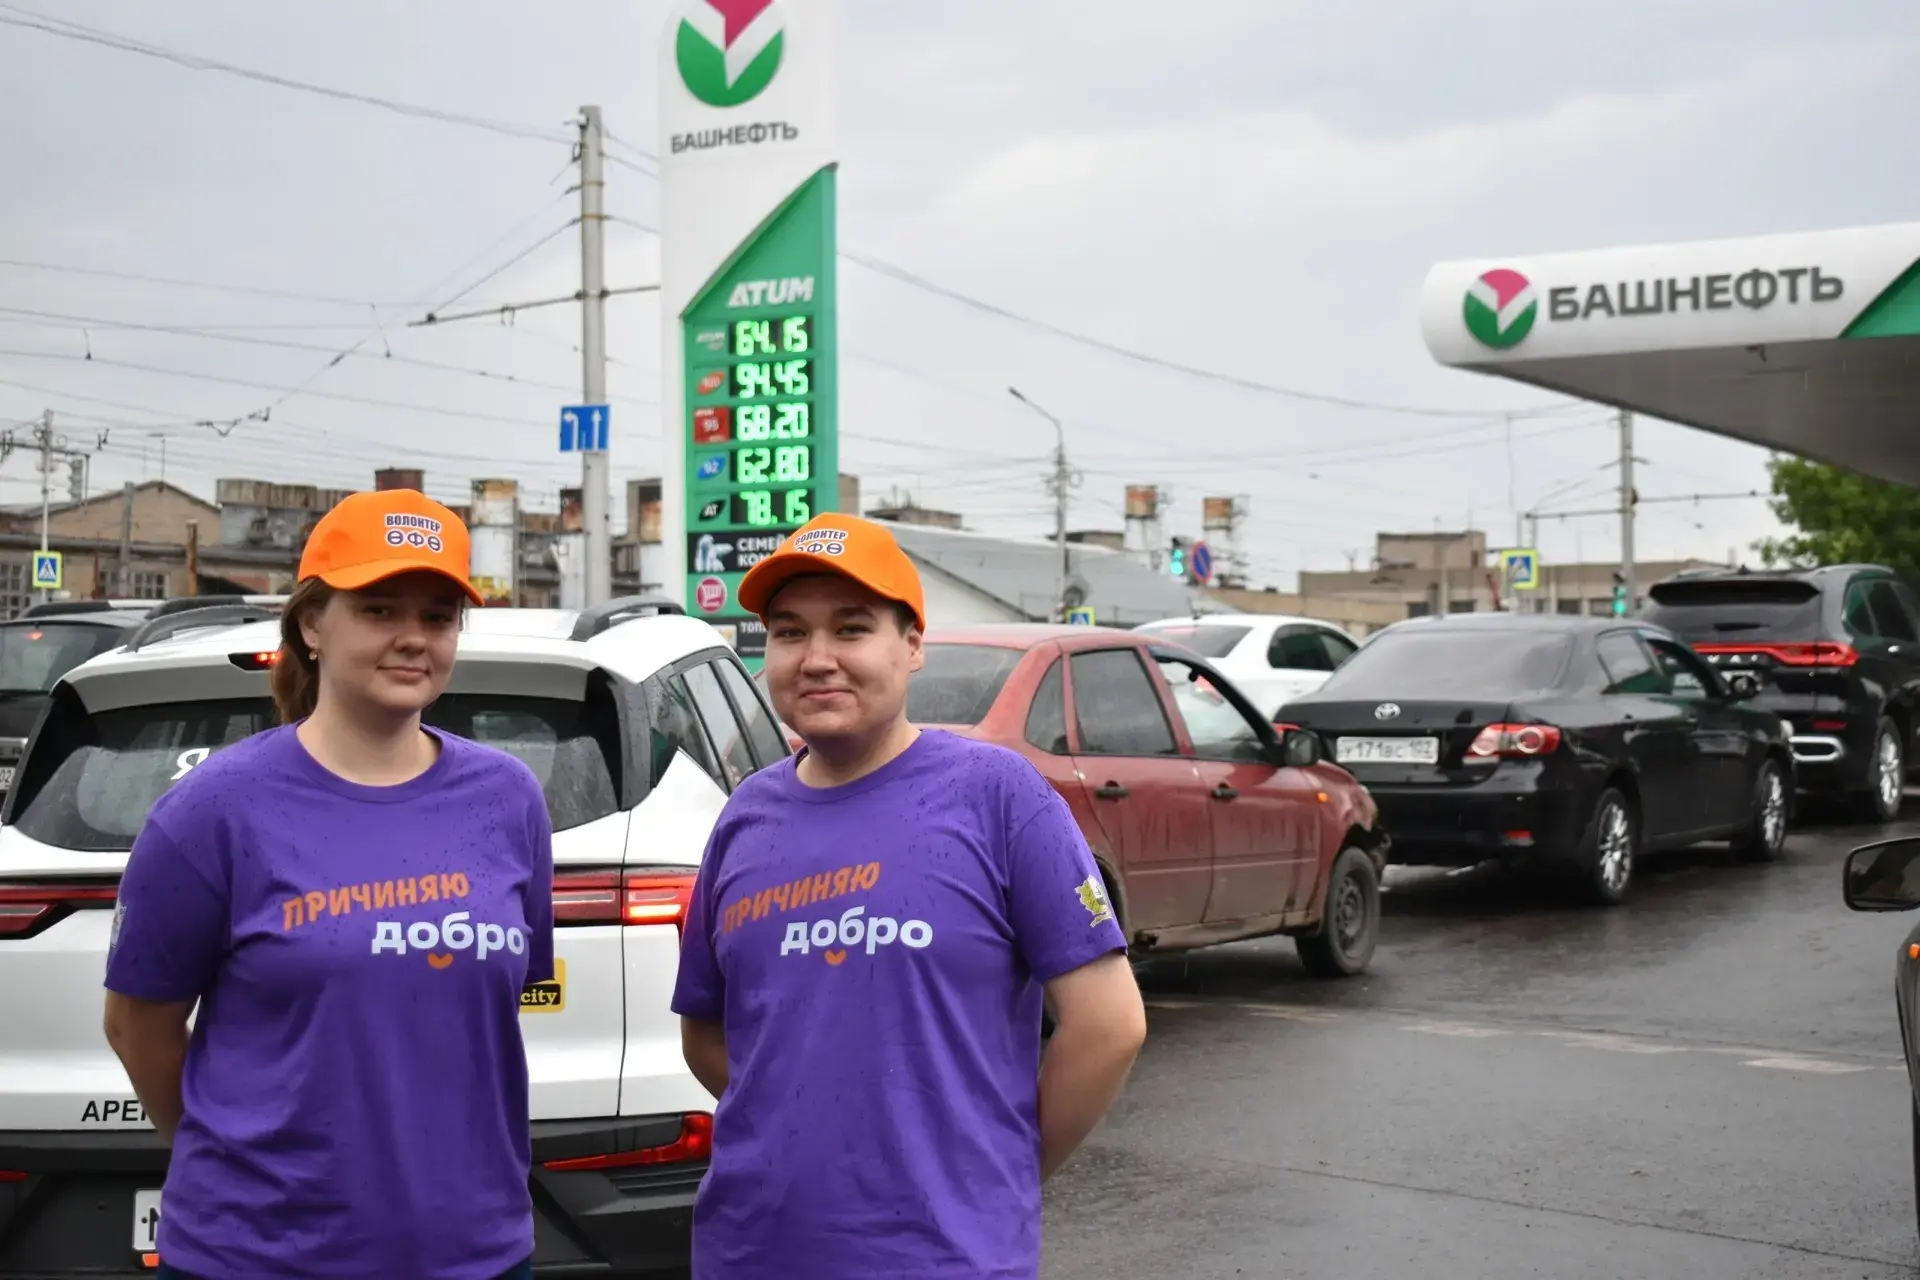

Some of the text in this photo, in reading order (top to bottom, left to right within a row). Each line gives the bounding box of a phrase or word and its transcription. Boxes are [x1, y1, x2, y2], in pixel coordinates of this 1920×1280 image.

[671, 122, 798, 154] БАШНЕФТЬ
[727, 275, 815, 307] ATUM
[1548, 266, 1844, 321] БАШНЕФТЬ
[736, 316, 808, 356] 64.15
[736, 359, 809, 399] 94.45
[737, 402, 809, 441] 68.20
[703, 461, 720, 475] 92
[737, 445, 809, 484] 62.80
[386, 515, 441, 533] ВОЛОНТЕР
[740, 488, 810, 526] 78.15
[795, 530, 847, 546] ВОЛОНТЕР
[282, 872, 470, 931] ПРИЧИНЯЮ
[722, 861, 880, 935] ПРИЧИНЯЮ
[371, 911, 525, 960] добро
[780, 905, 933, 956] добро
[521, 988, 557, 1006] city
